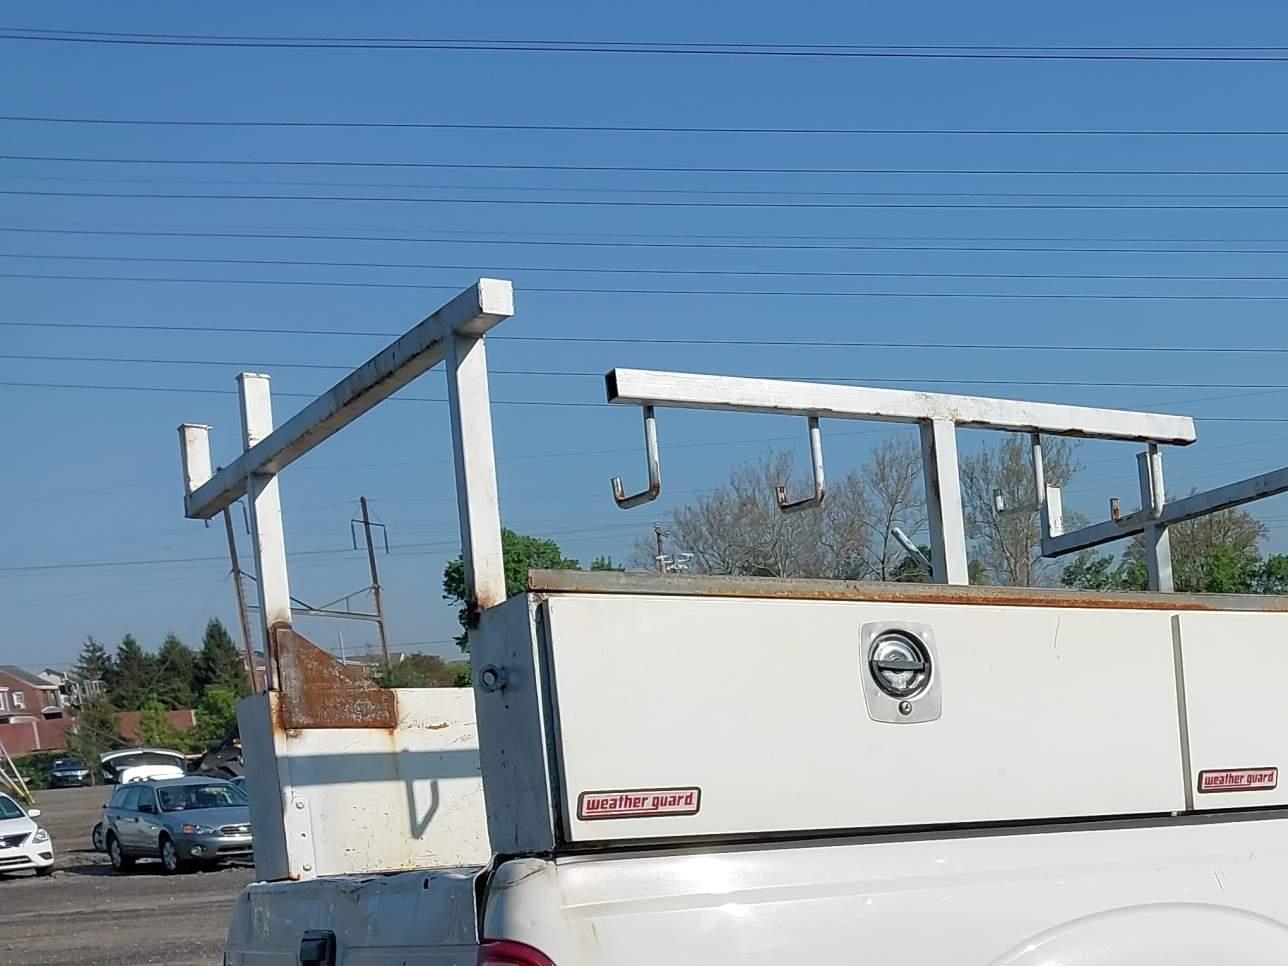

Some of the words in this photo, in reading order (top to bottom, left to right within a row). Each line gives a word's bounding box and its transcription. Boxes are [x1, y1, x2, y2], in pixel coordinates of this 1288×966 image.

[1204, 773, 1245, 786] weather
[1246, 771, 1274, 785] guard
[586, 795, 649, 812] weather
[651, 792, 694, 811] guard
